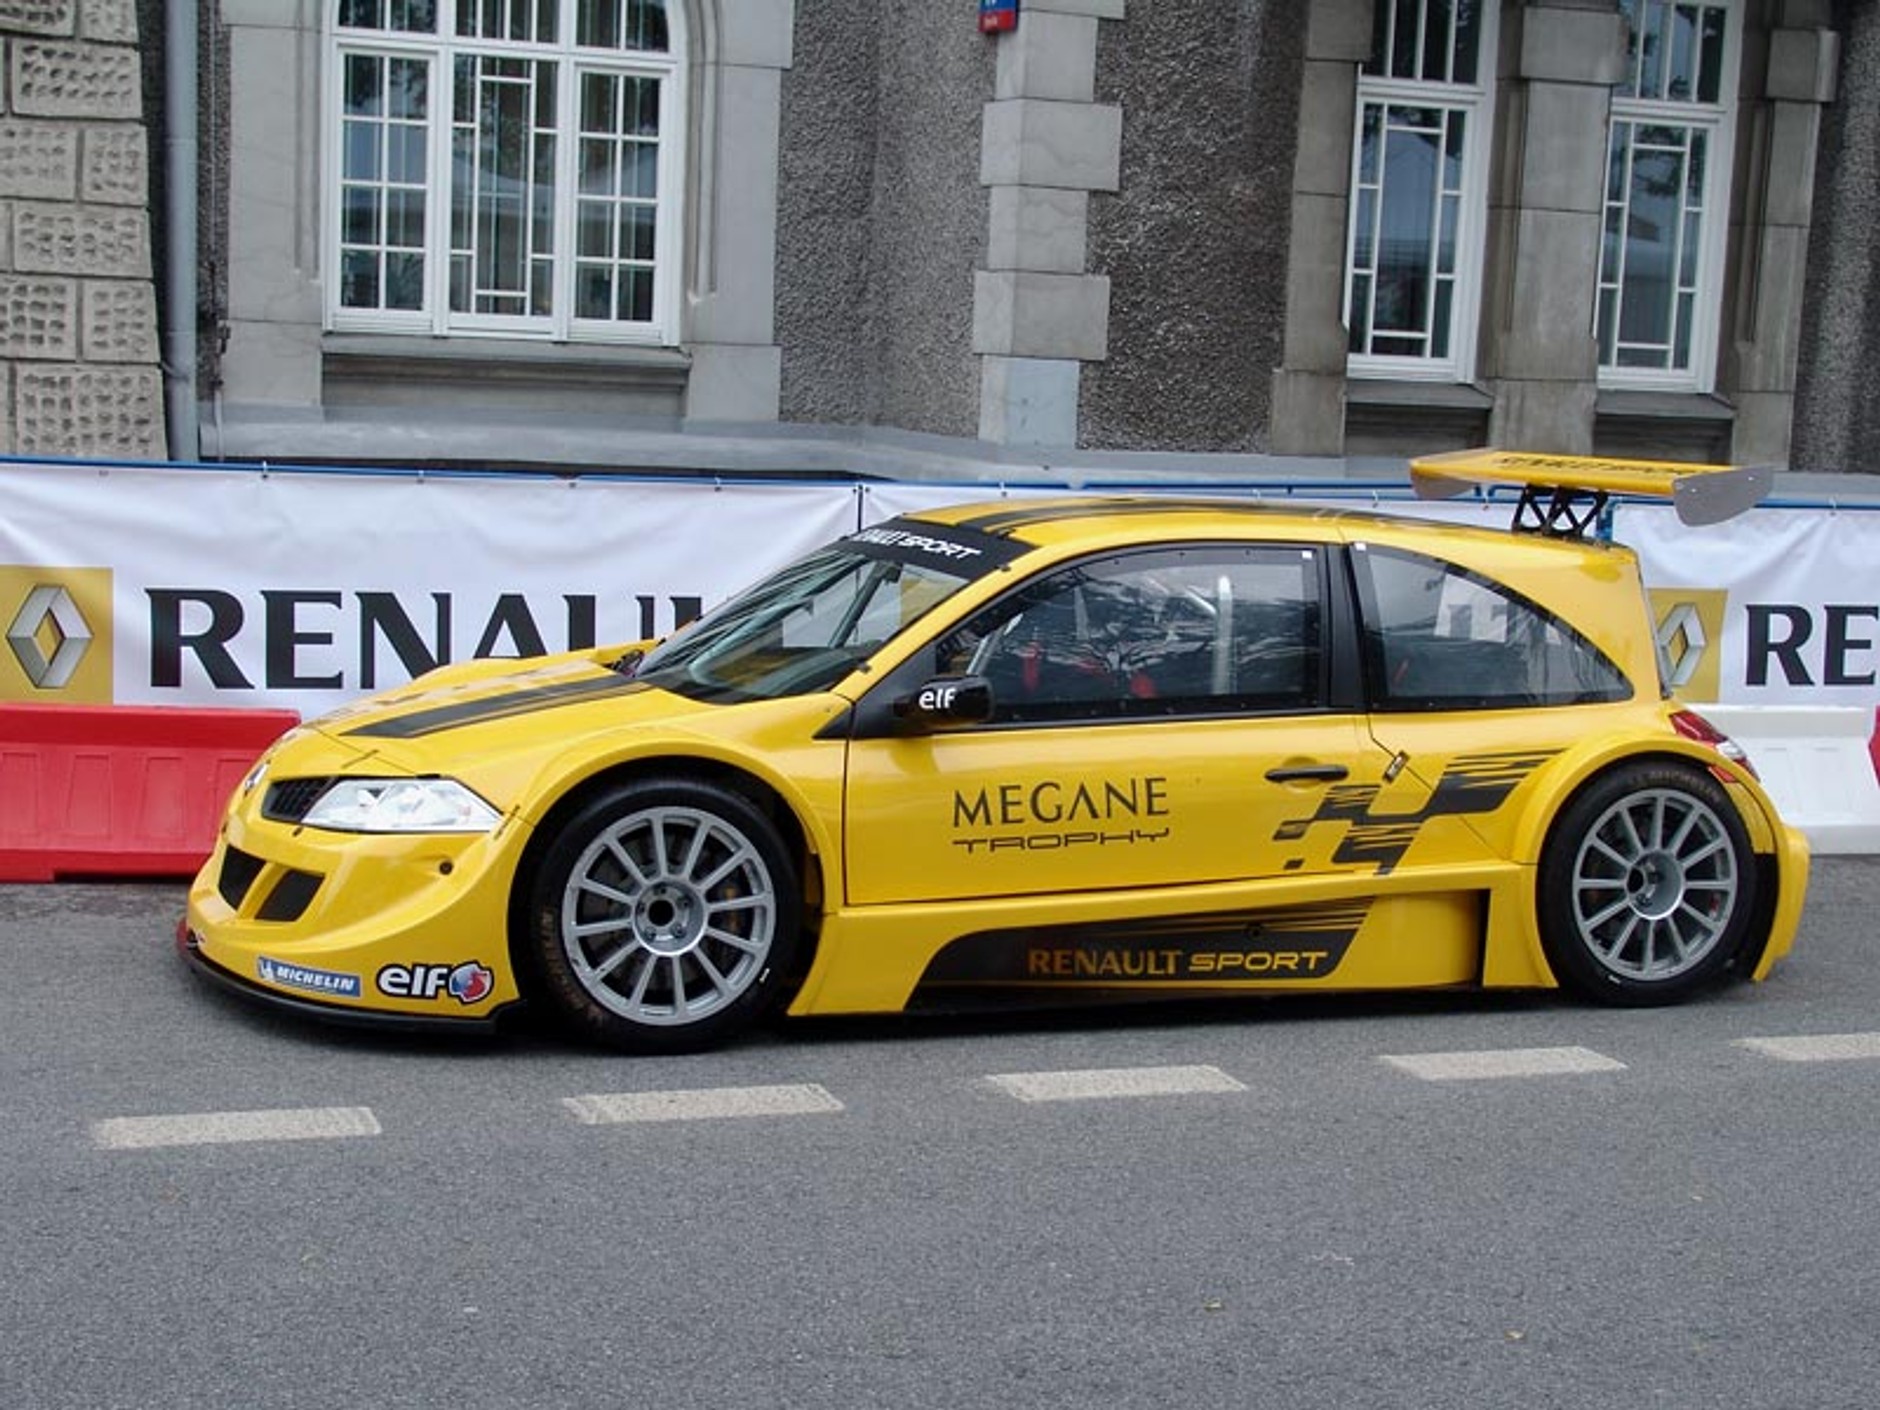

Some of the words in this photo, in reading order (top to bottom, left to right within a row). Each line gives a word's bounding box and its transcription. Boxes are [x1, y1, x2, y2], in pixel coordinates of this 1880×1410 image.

[898, 534, 982, 560] SPORT
[144, 588, 703, 690] RENAU
[1745, 604, 1879, 685] RE
[918, 687, 957, 710] elf
[953, 777, 1170, 828] MEGANE
[952, 827, 1170, 854] TROPHY
[1028, 950, 1183, 975] RENAULT
[1188, 951, 1328, 972] SPORT
[276, 967, 355, 991] MICHELIN
[378, 965, 448, 997] elf
